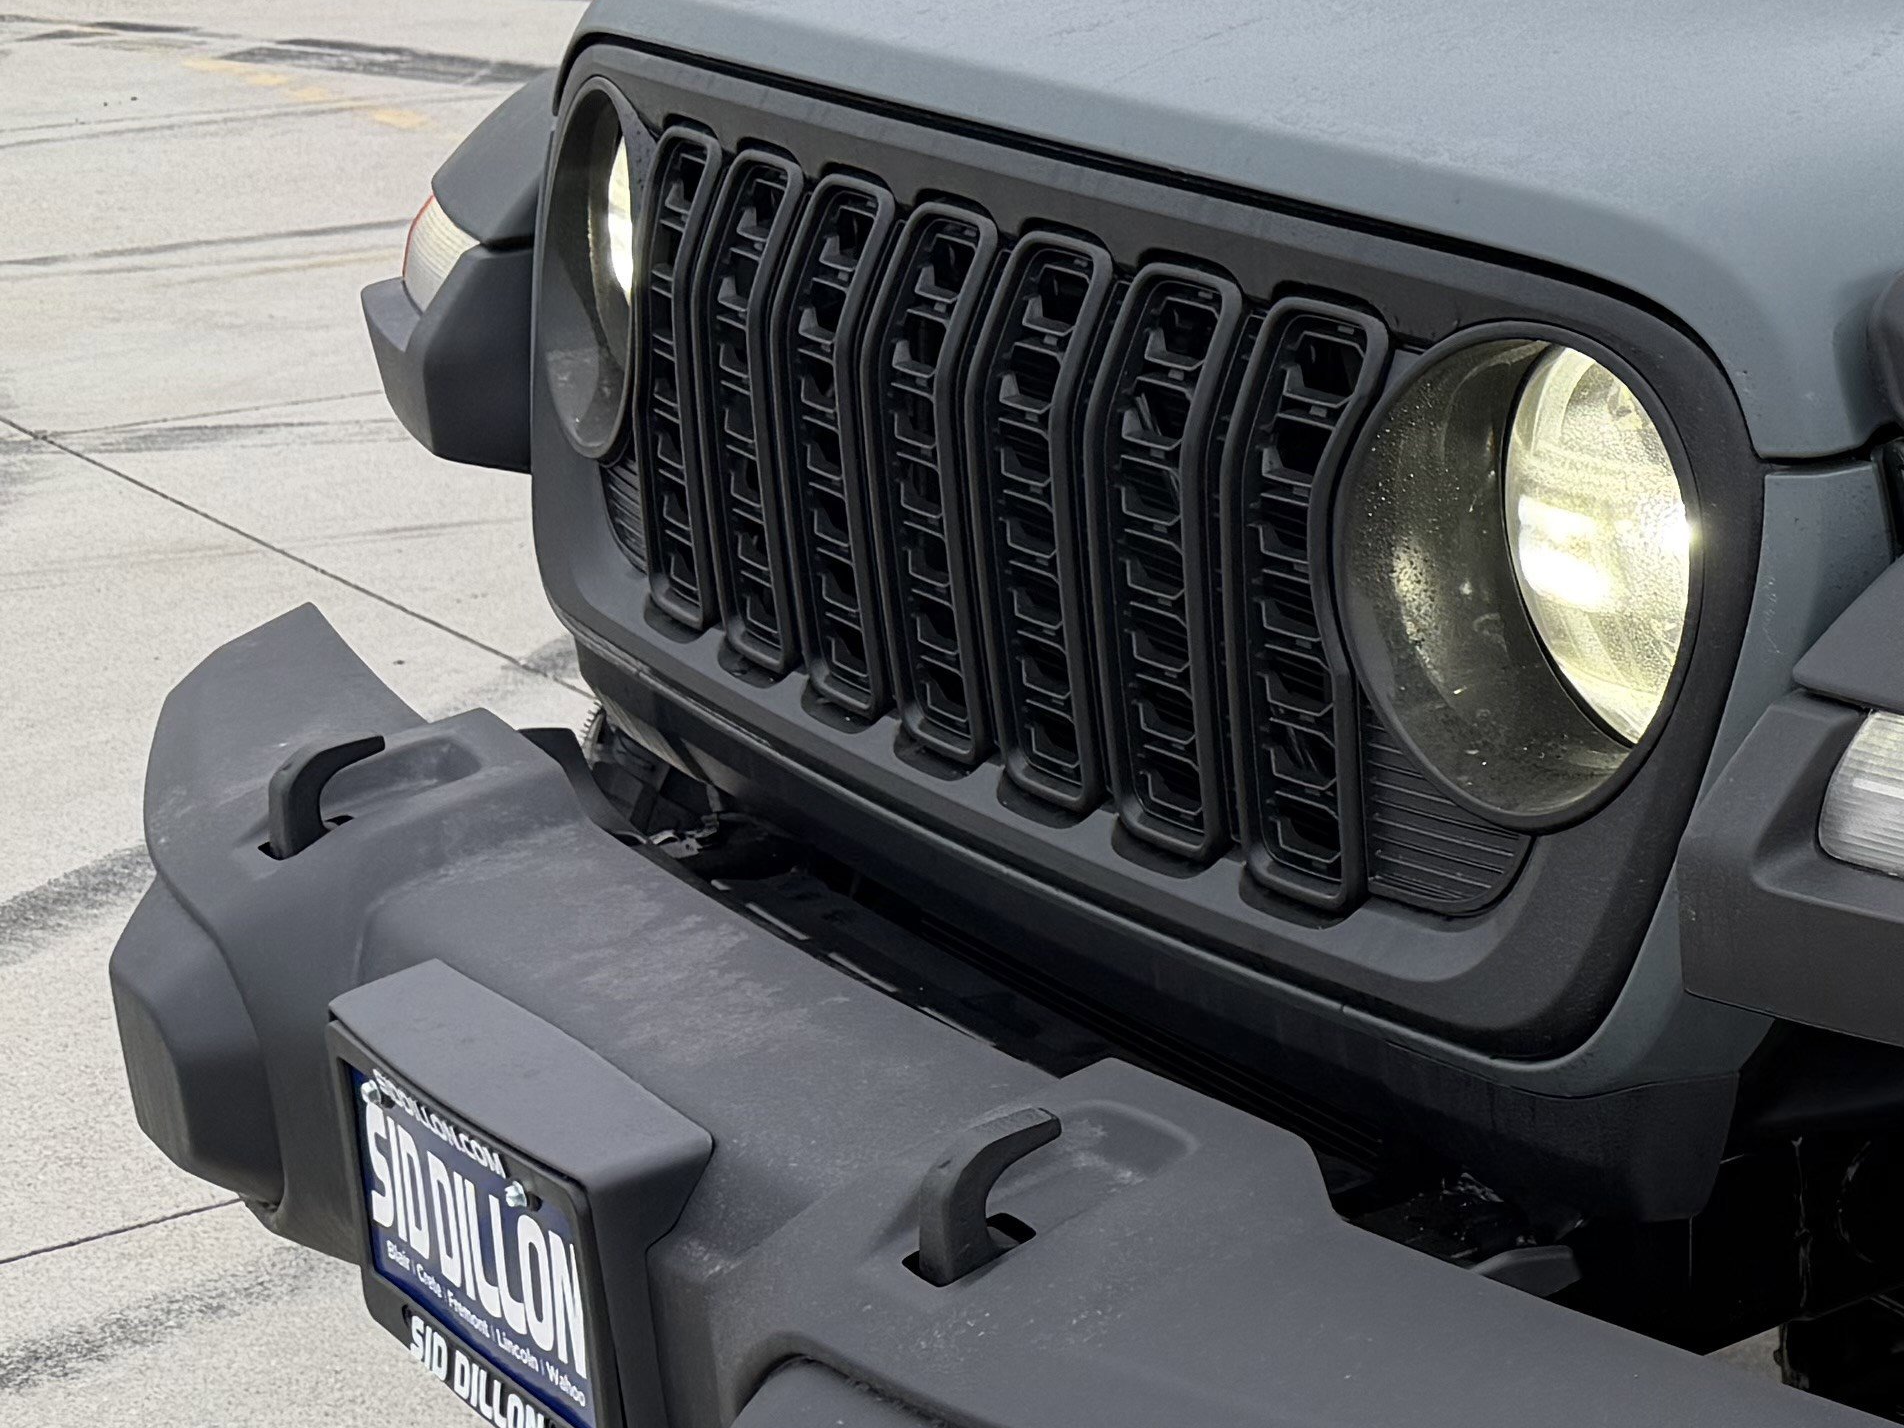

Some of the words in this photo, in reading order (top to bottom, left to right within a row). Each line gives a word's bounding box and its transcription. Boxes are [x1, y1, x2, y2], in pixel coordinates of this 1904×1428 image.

[365, 1100, 431, 1261] SID
[426, 1149, 588, 1380] DILLON
[386, 1239, 411, 1271] Blair
[446, 1288, 491, 1339] Fremont
[495, 1328, 539, 1372] Lincoln
[545, 1361, 586, 1407] Wahoo
[410, 1314, 449, 1382] SID
